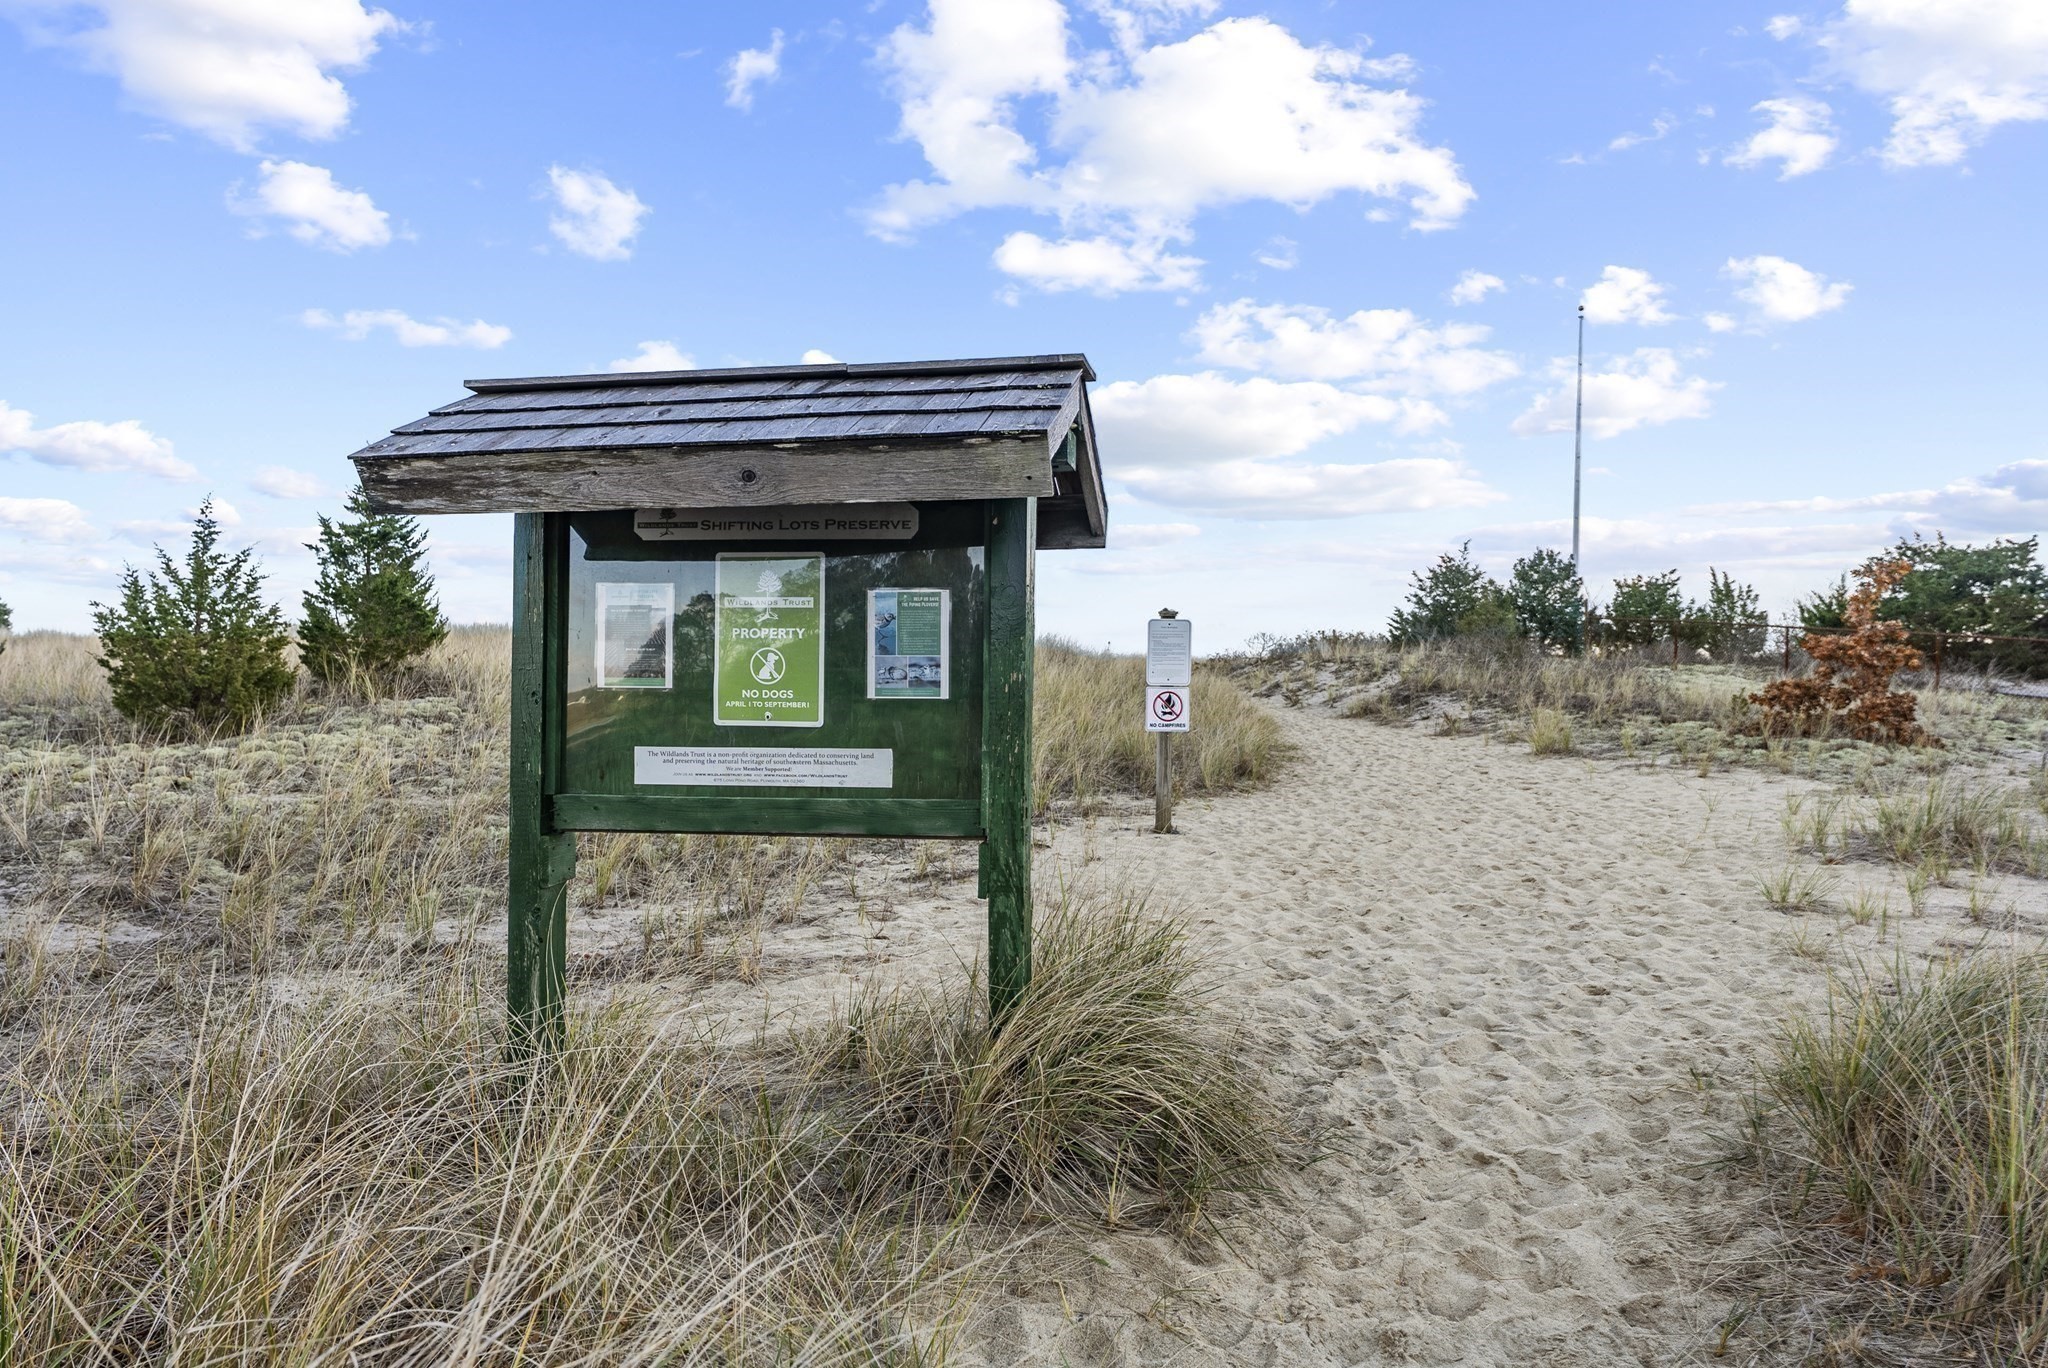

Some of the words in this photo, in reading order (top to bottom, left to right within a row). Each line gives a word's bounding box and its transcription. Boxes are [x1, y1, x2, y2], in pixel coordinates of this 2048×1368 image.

[700, 519, 774, 532] SHIFTING
[778, 518, 820, 531] LOTS
[824, 518, 912, 531] PRESERVE
[727, 598, 779, 606] WILDLANDS
[783, 598, 812, 606] TRUST
[732, 627, 806, 639] PROPERTY
[741, 689, 759, 698] NO
[762, 689, 794, 699] DOGS
[718, 751, 749, 760] non-profit
[749, 752, 787, 760] organization
[787, 751, 818, 759] dedicated
[826, 752, 860, 761] conserving
[674, 758, 706, 766] preserving
[740, 758, 765, 766] heritage
